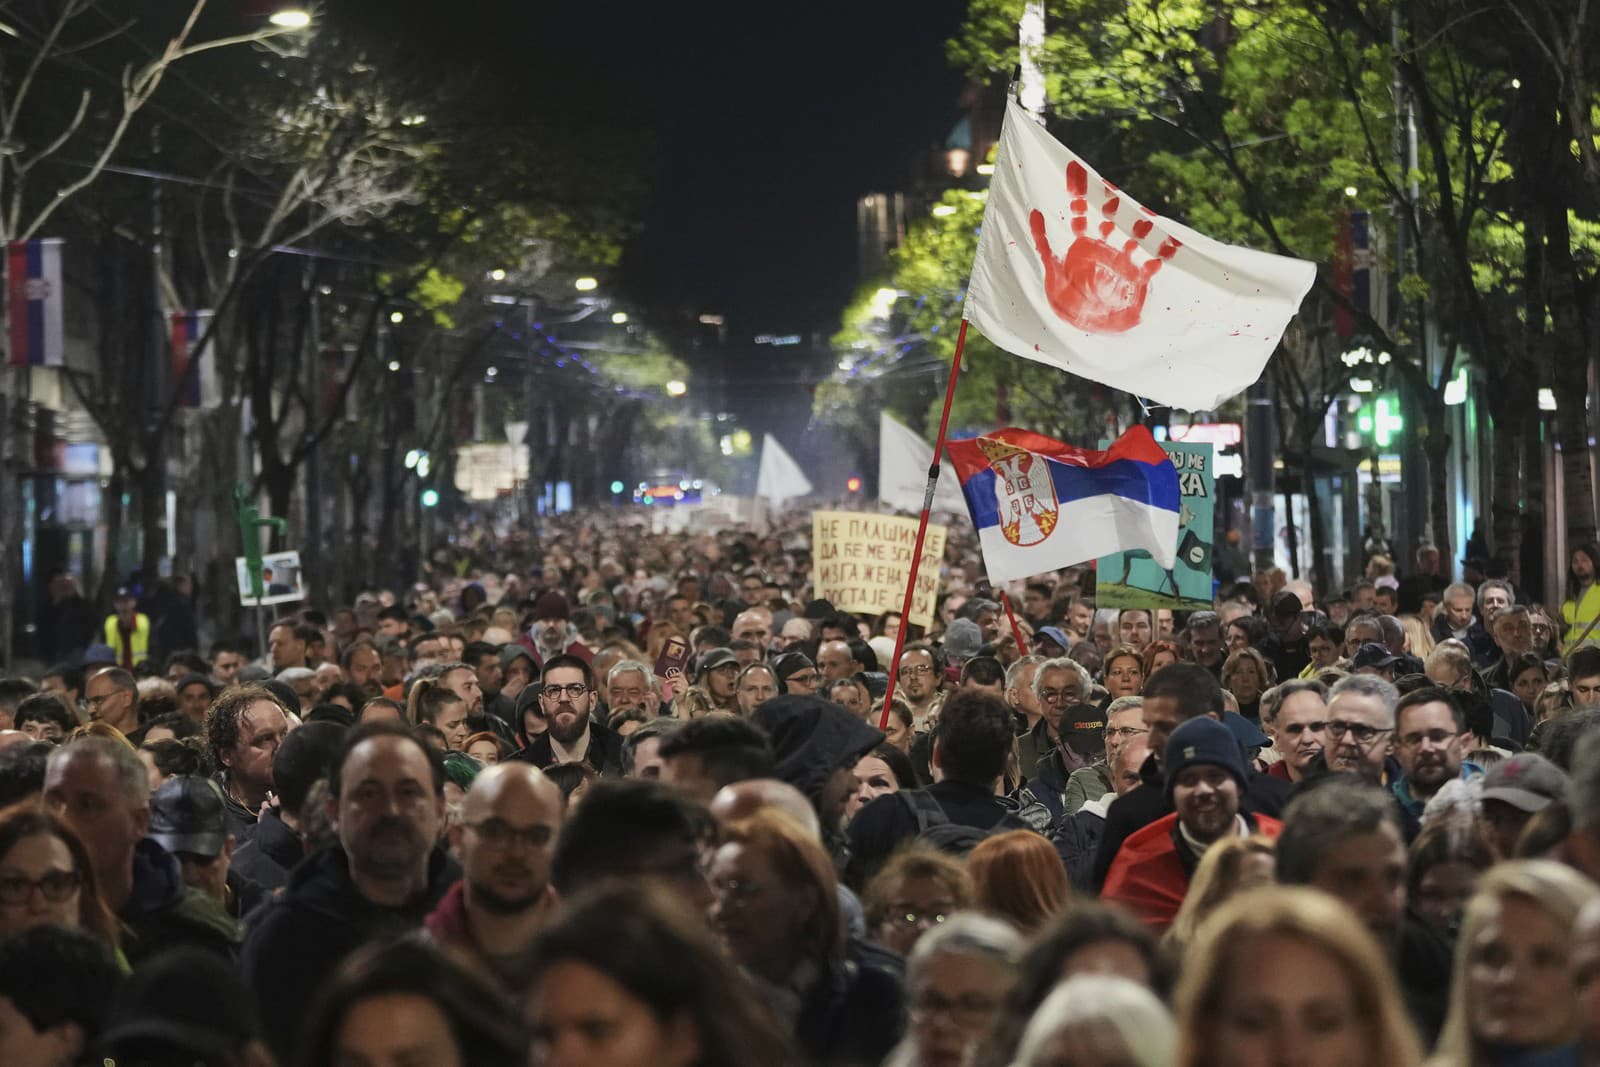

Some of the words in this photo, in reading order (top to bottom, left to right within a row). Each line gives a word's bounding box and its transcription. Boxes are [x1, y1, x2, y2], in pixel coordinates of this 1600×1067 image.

[1188, 453, 1205, 471] ME
[1179, 472, 1207, 497] KA
[820, 519, 840, 539] НЕ
[820, 543, 838, 560] ДА
[867, 544, 886, 561] МЕ
